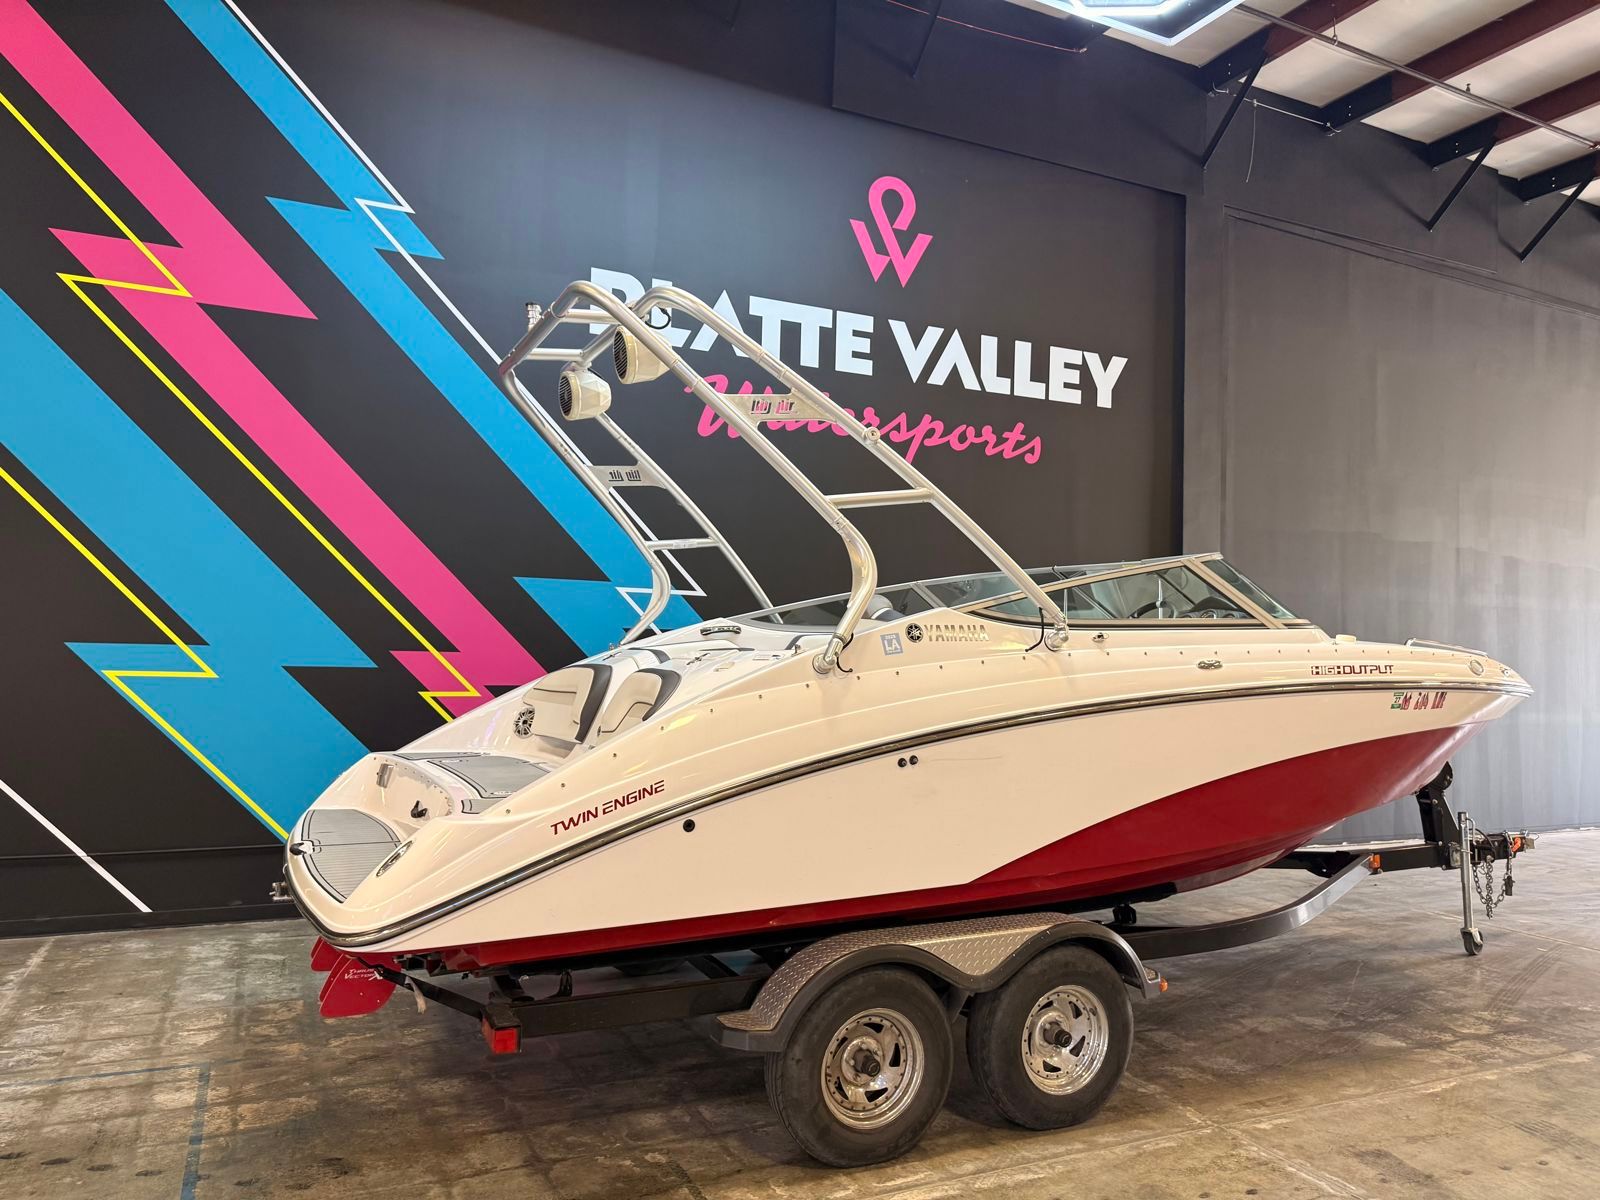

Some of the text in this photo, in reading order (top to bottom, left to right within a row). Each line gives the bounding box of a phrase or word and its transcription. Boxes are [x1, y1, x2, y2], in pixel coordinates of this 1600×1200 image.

[589, 266, 1129, 409] PLATTE VALLEY
[924, 624, 990, 642] YAMAHA
[550, 779, 665, 836] TWIN ENGINE
